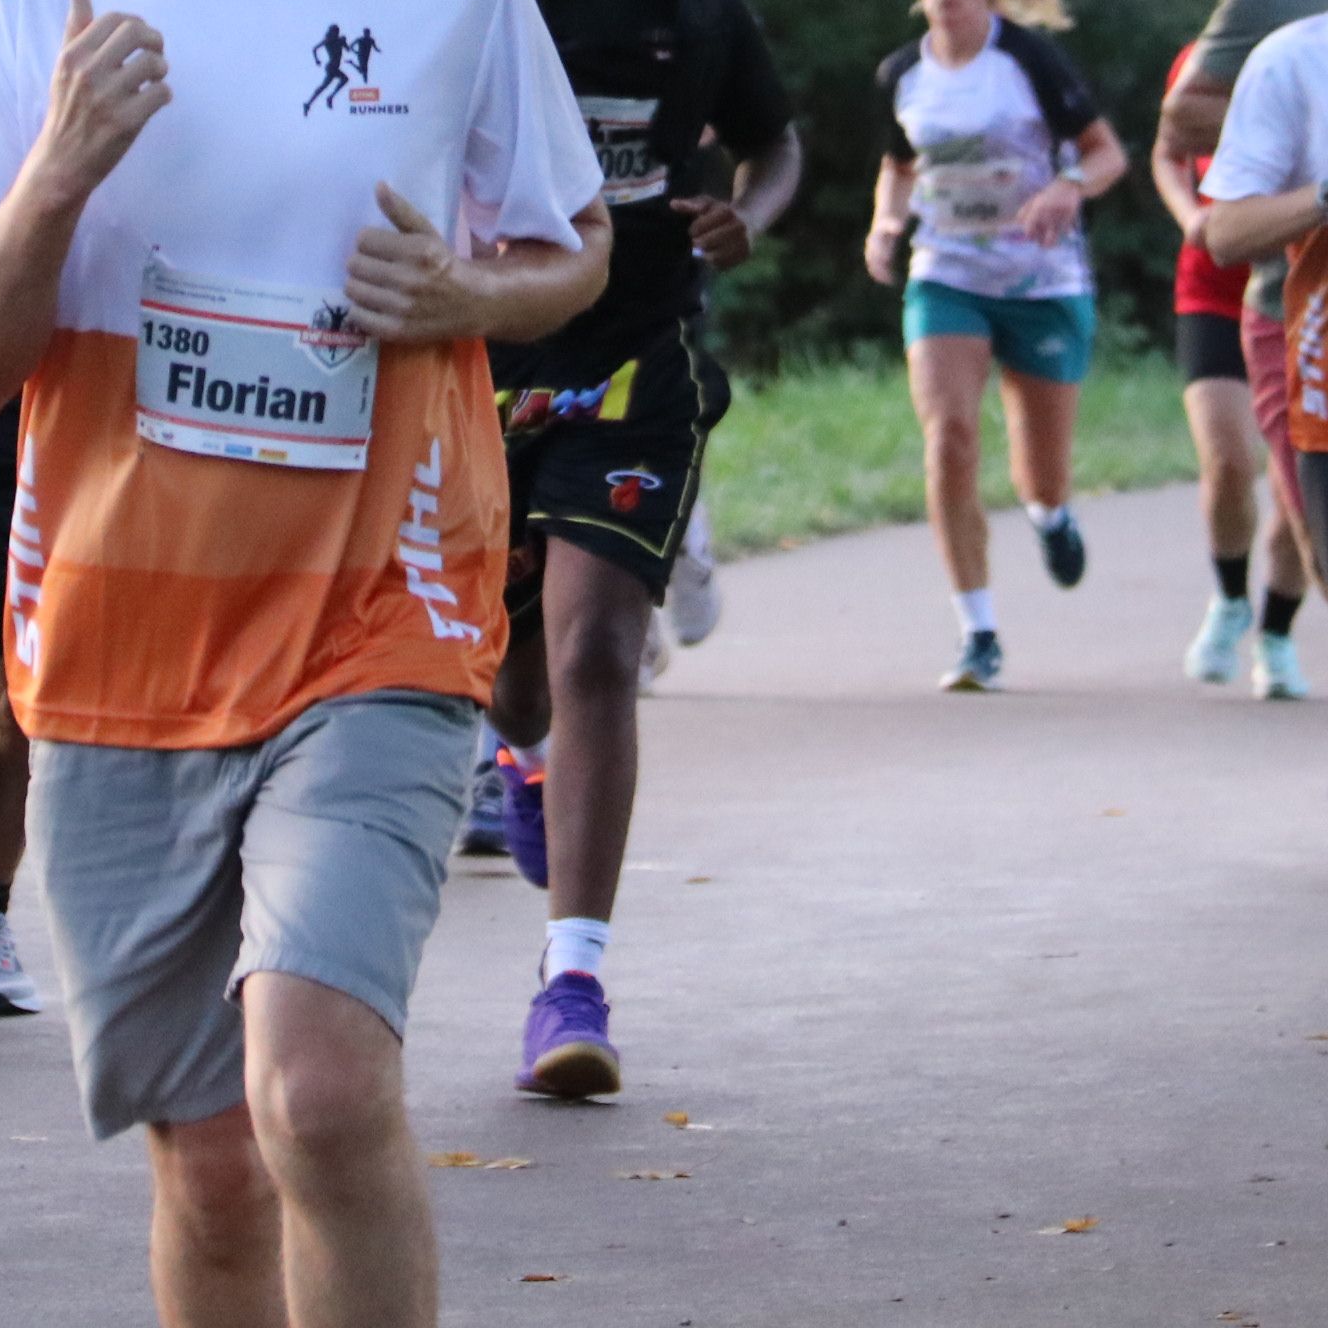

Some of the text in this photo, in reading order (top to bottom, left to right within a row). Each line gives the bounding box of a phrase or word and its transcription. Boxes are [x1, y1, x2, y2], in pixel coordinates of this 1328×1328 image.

[350, 105, 410, 115] RUNNERS
[143, 320, 210, 356] 1380
[166, 362, 328, 424] Florian
[398, 437, 482, 645] STIHL
